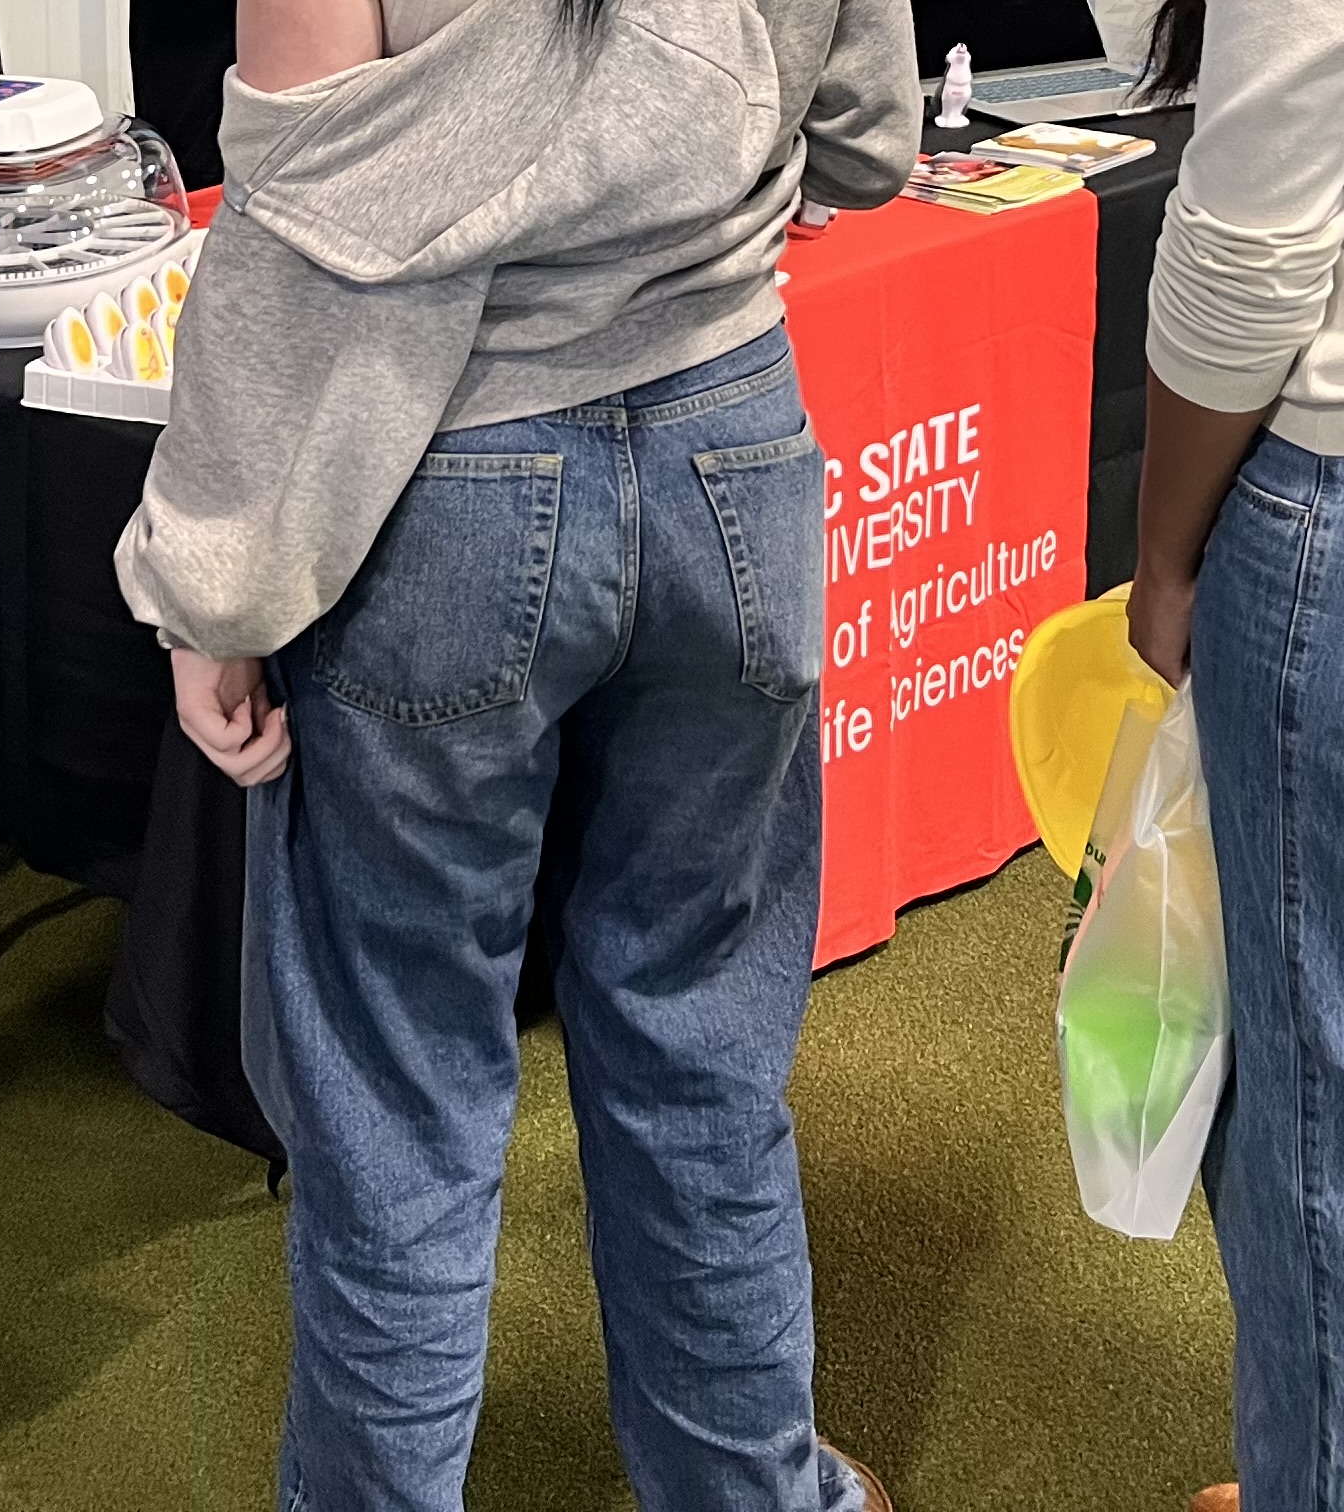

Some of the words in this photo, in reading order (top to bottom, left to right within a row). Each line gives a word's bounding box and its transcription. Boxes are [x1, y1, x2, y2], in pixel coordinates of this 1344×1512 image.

[824, 458, 843, 519] C
[859, 403, 981, 503] STATE
[824, 470, 981, 588] IVERSITY
[832, 600, 873, 668] of
[823, 699, 873, 764] ife
